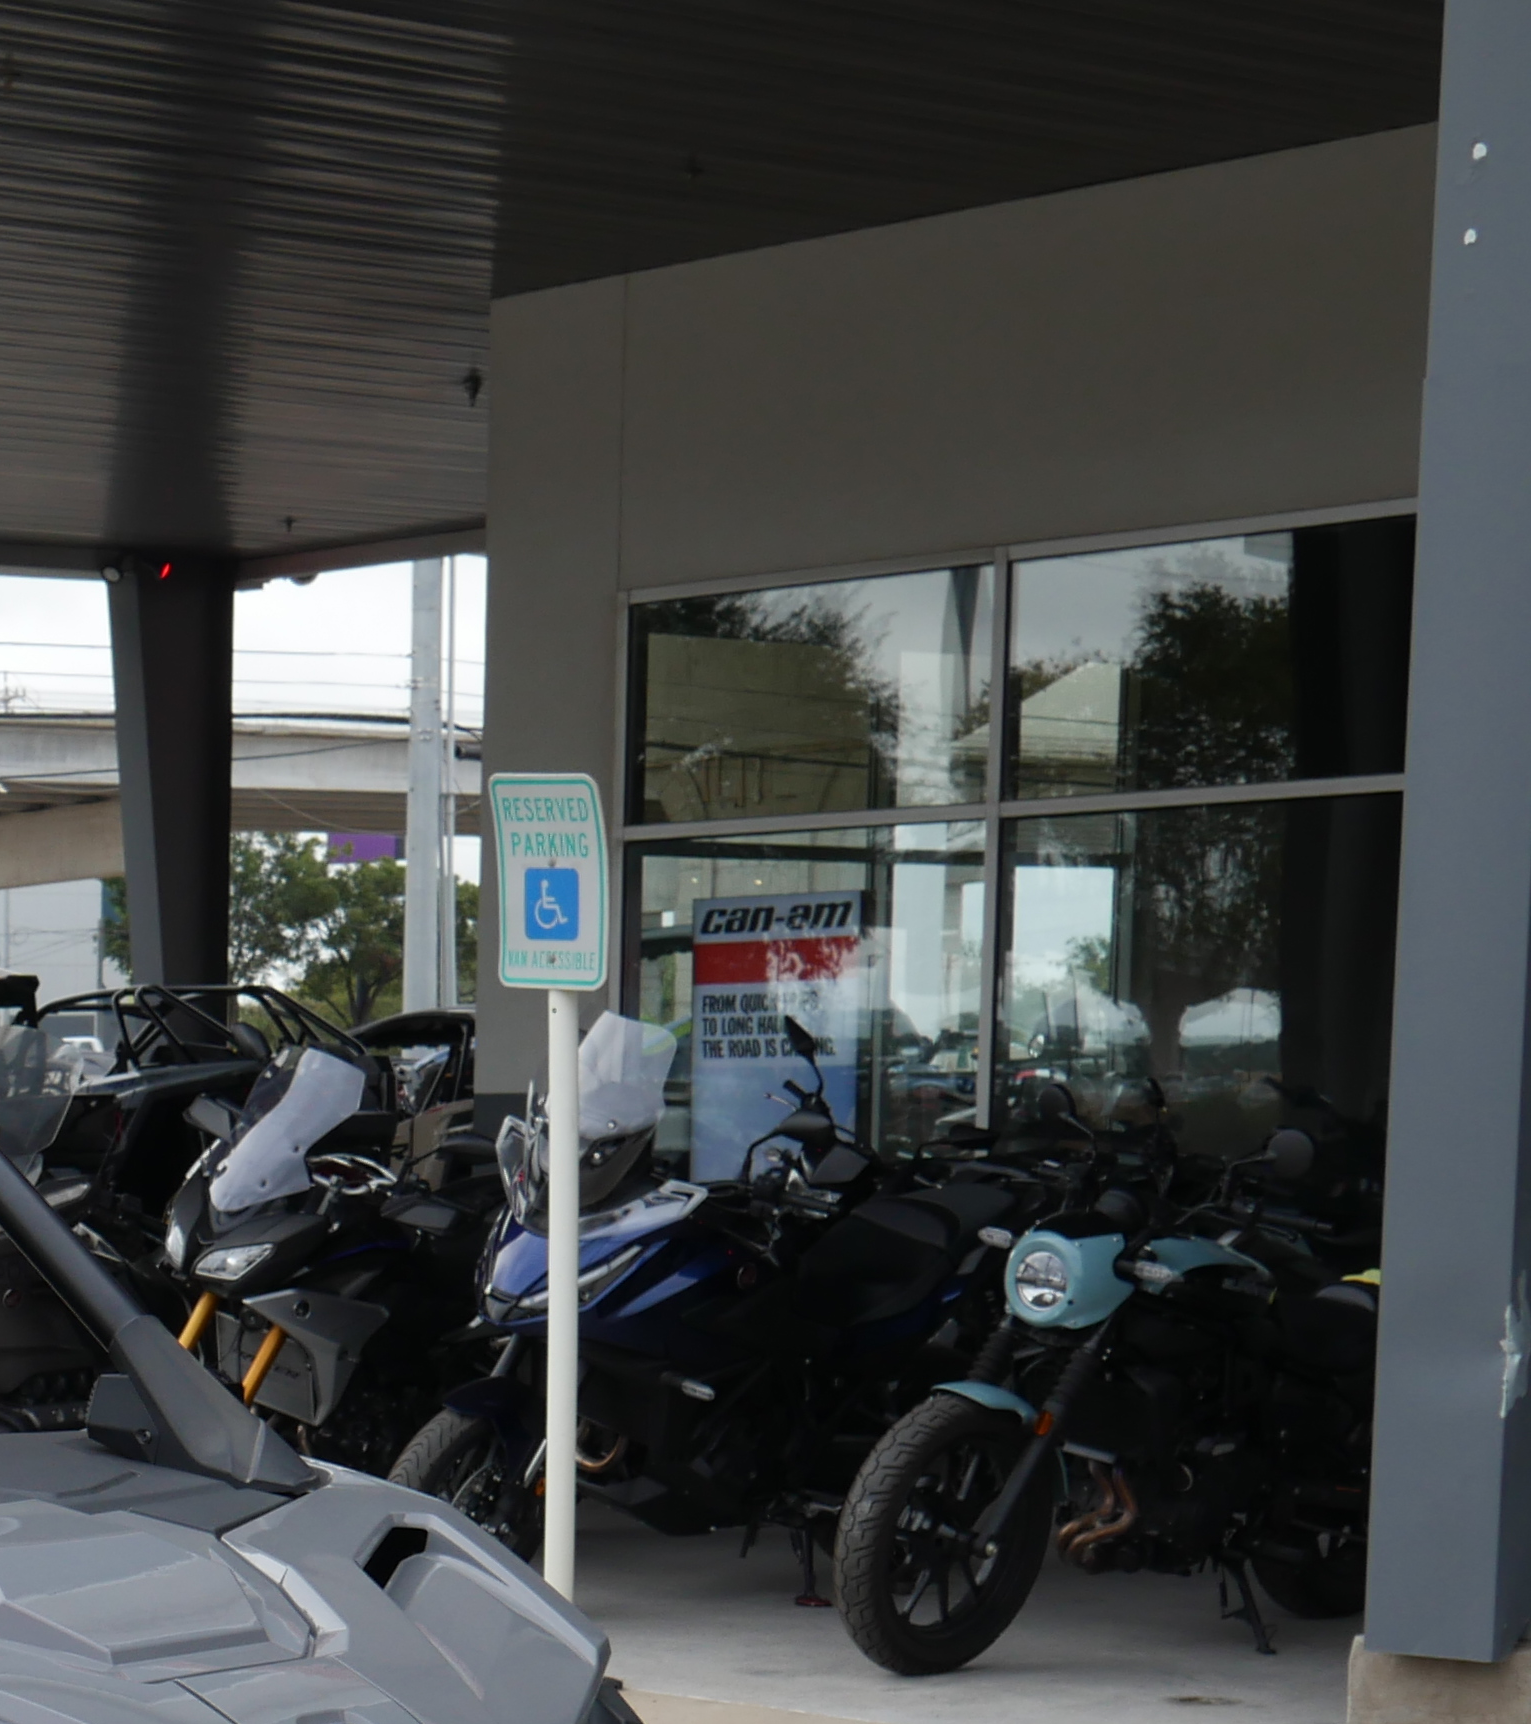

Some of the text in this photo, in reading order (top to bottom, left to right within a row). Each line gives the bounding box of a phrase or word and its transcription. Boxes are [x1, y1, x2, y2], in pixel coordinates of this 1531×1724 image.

[502, 797, 589, 822] RESERVED
[510, 832, 589, 858] PARKING
[701, 901, 853, 935] can-am
[702, 994, 737, 1013] FROM
[702, 1017, 717, 1036] TO
[721, 1016, 754, 1035] LONG
[702, 1039, 725, 1058] THE
[728, 1038, 762, 1058] ROAD
[765, 1038, 777, 1057] IS
